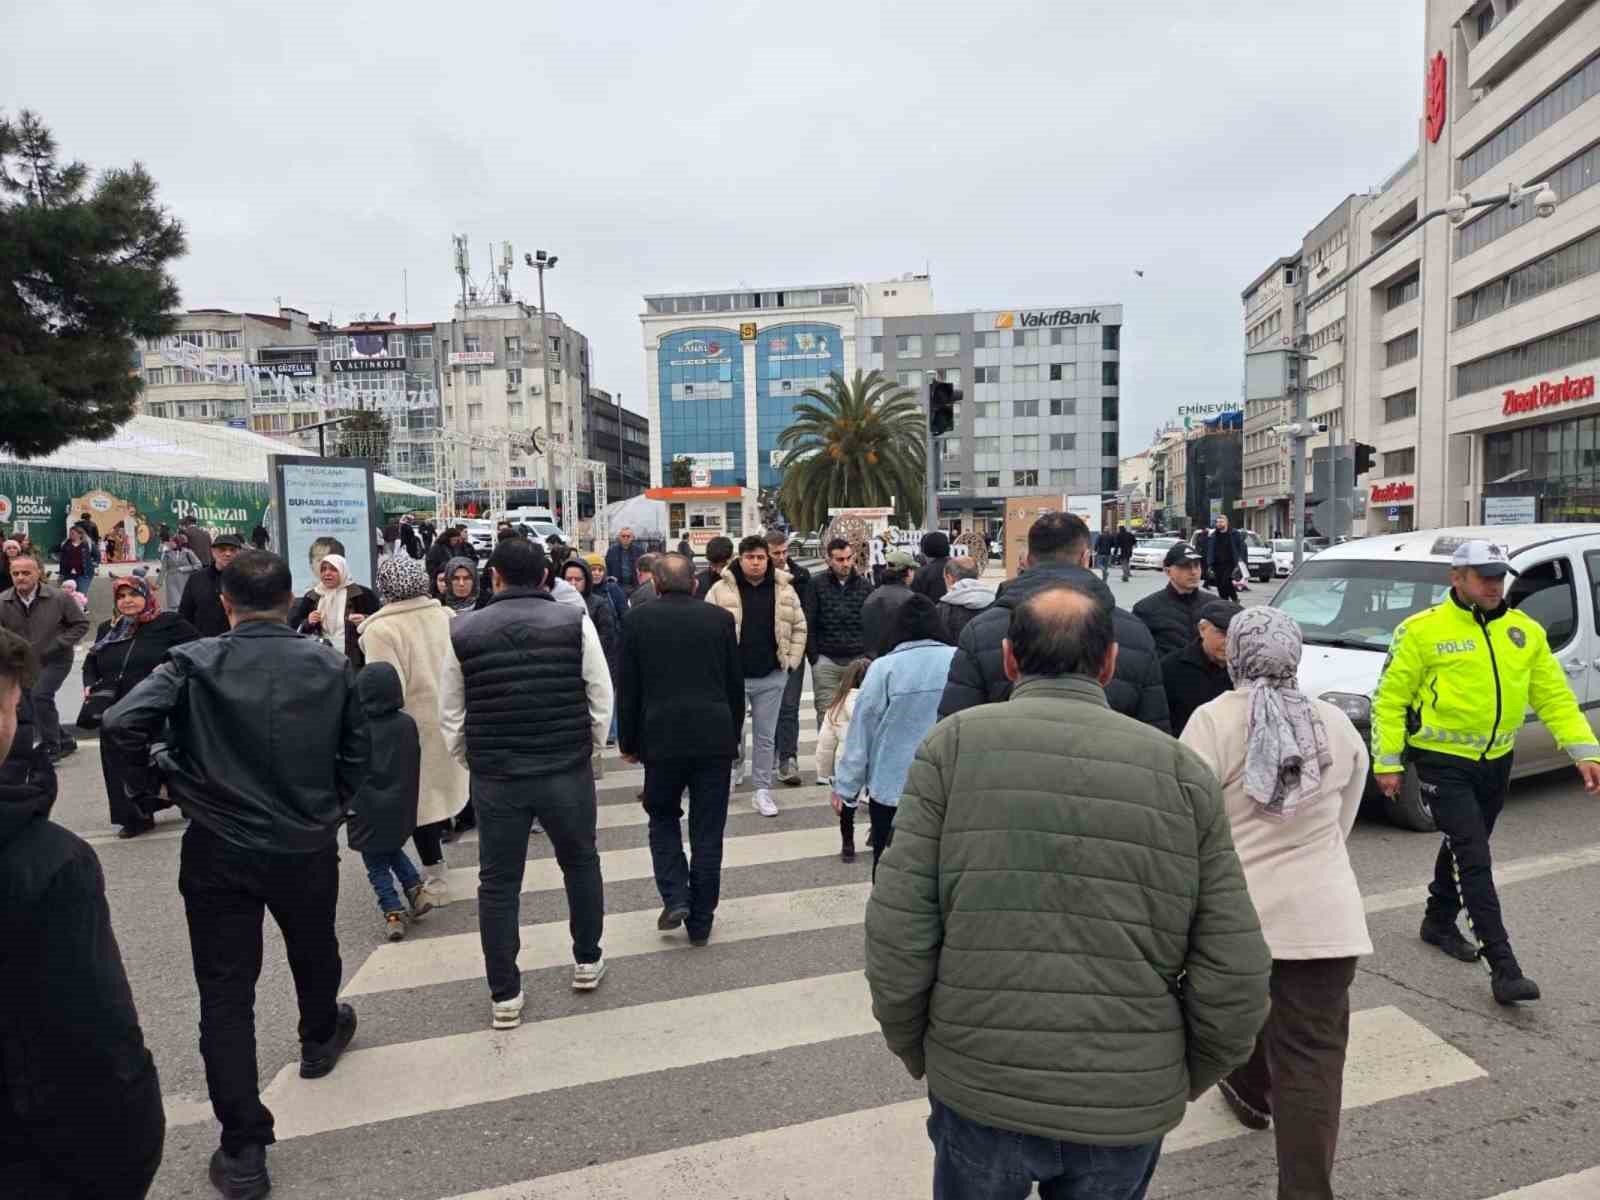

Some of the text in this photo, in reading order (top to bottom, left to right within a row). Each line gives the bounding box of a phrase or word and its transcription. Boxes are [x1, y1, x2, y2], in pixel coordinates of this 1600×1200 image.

[1020, 309, 1102, 327] VakıfBank
[1503, 375, 1595, 416] Ziraat Bankası
[1178, 402, 1238, 416] EMİNEVİM
